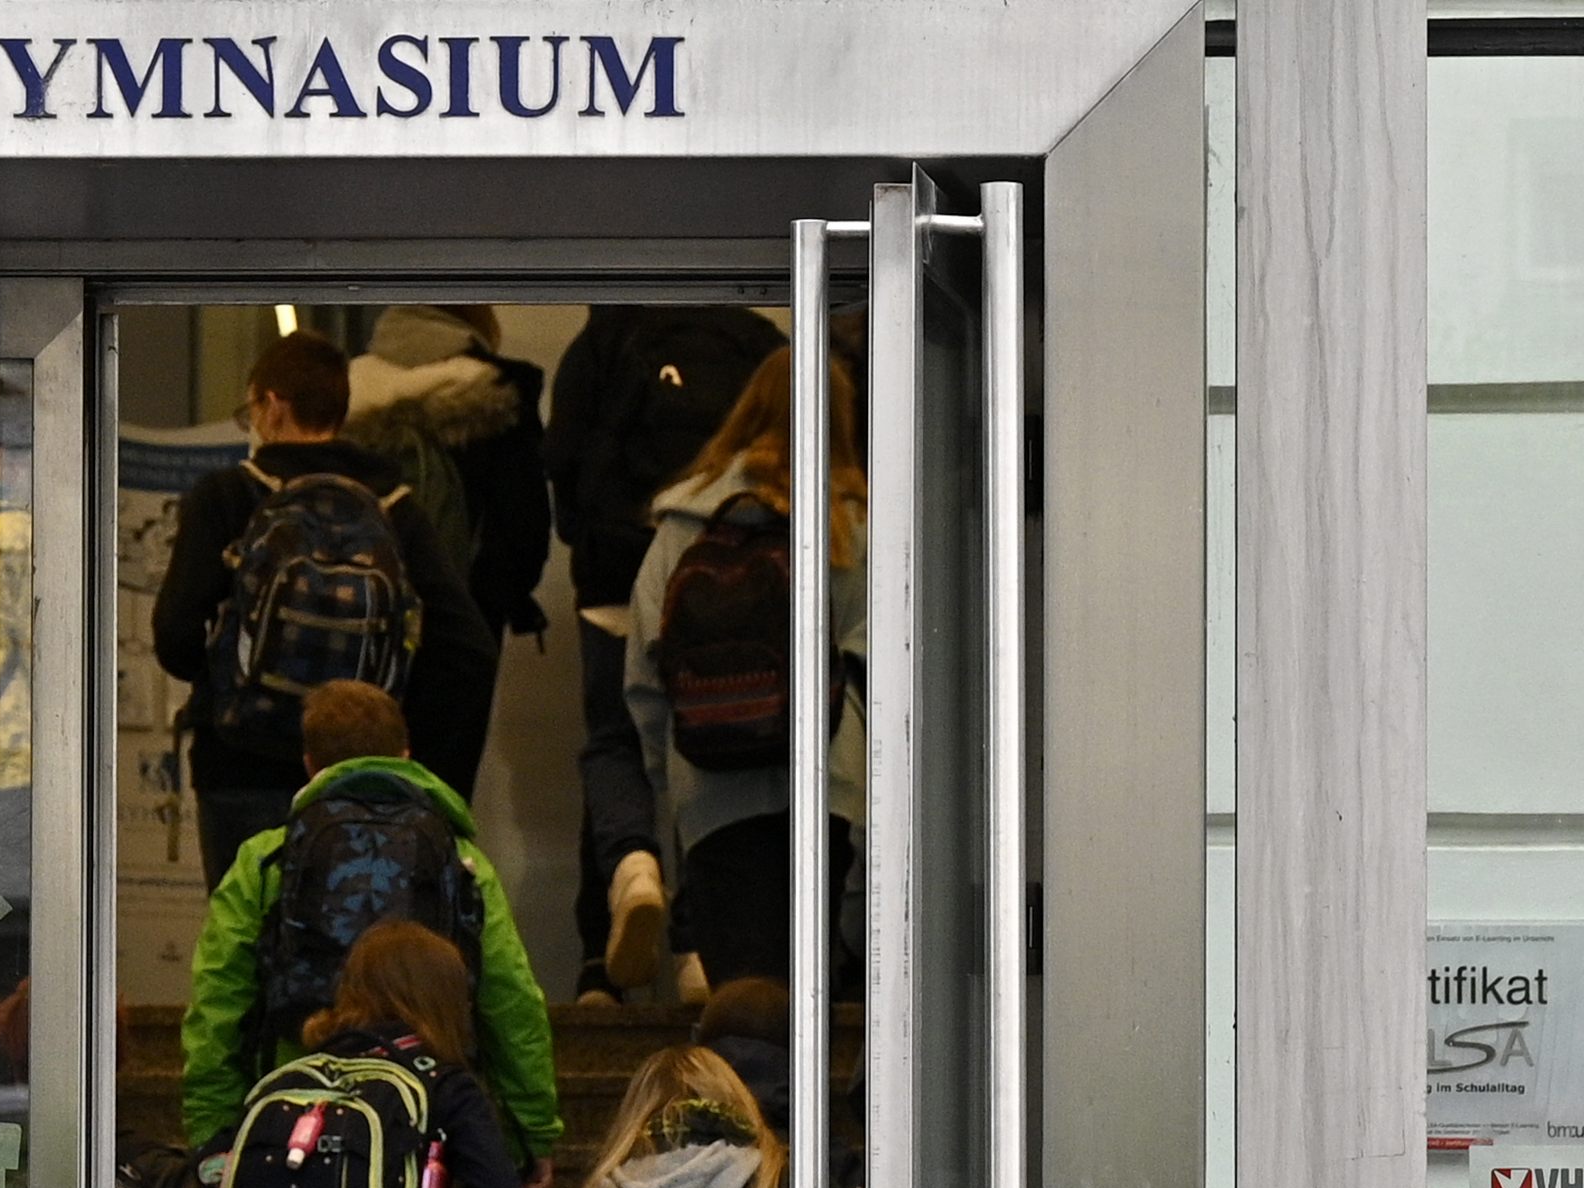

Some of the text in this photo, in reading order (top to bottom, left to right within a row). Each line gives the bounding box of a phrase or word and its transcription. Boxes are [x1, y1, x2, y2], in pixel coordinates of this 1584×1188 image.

[1427, 966, 1548, 1004] tifikat
[1436, 1082, 1451, 1093] im
[1456, 1082, 1525, 1094] Schulalltag
